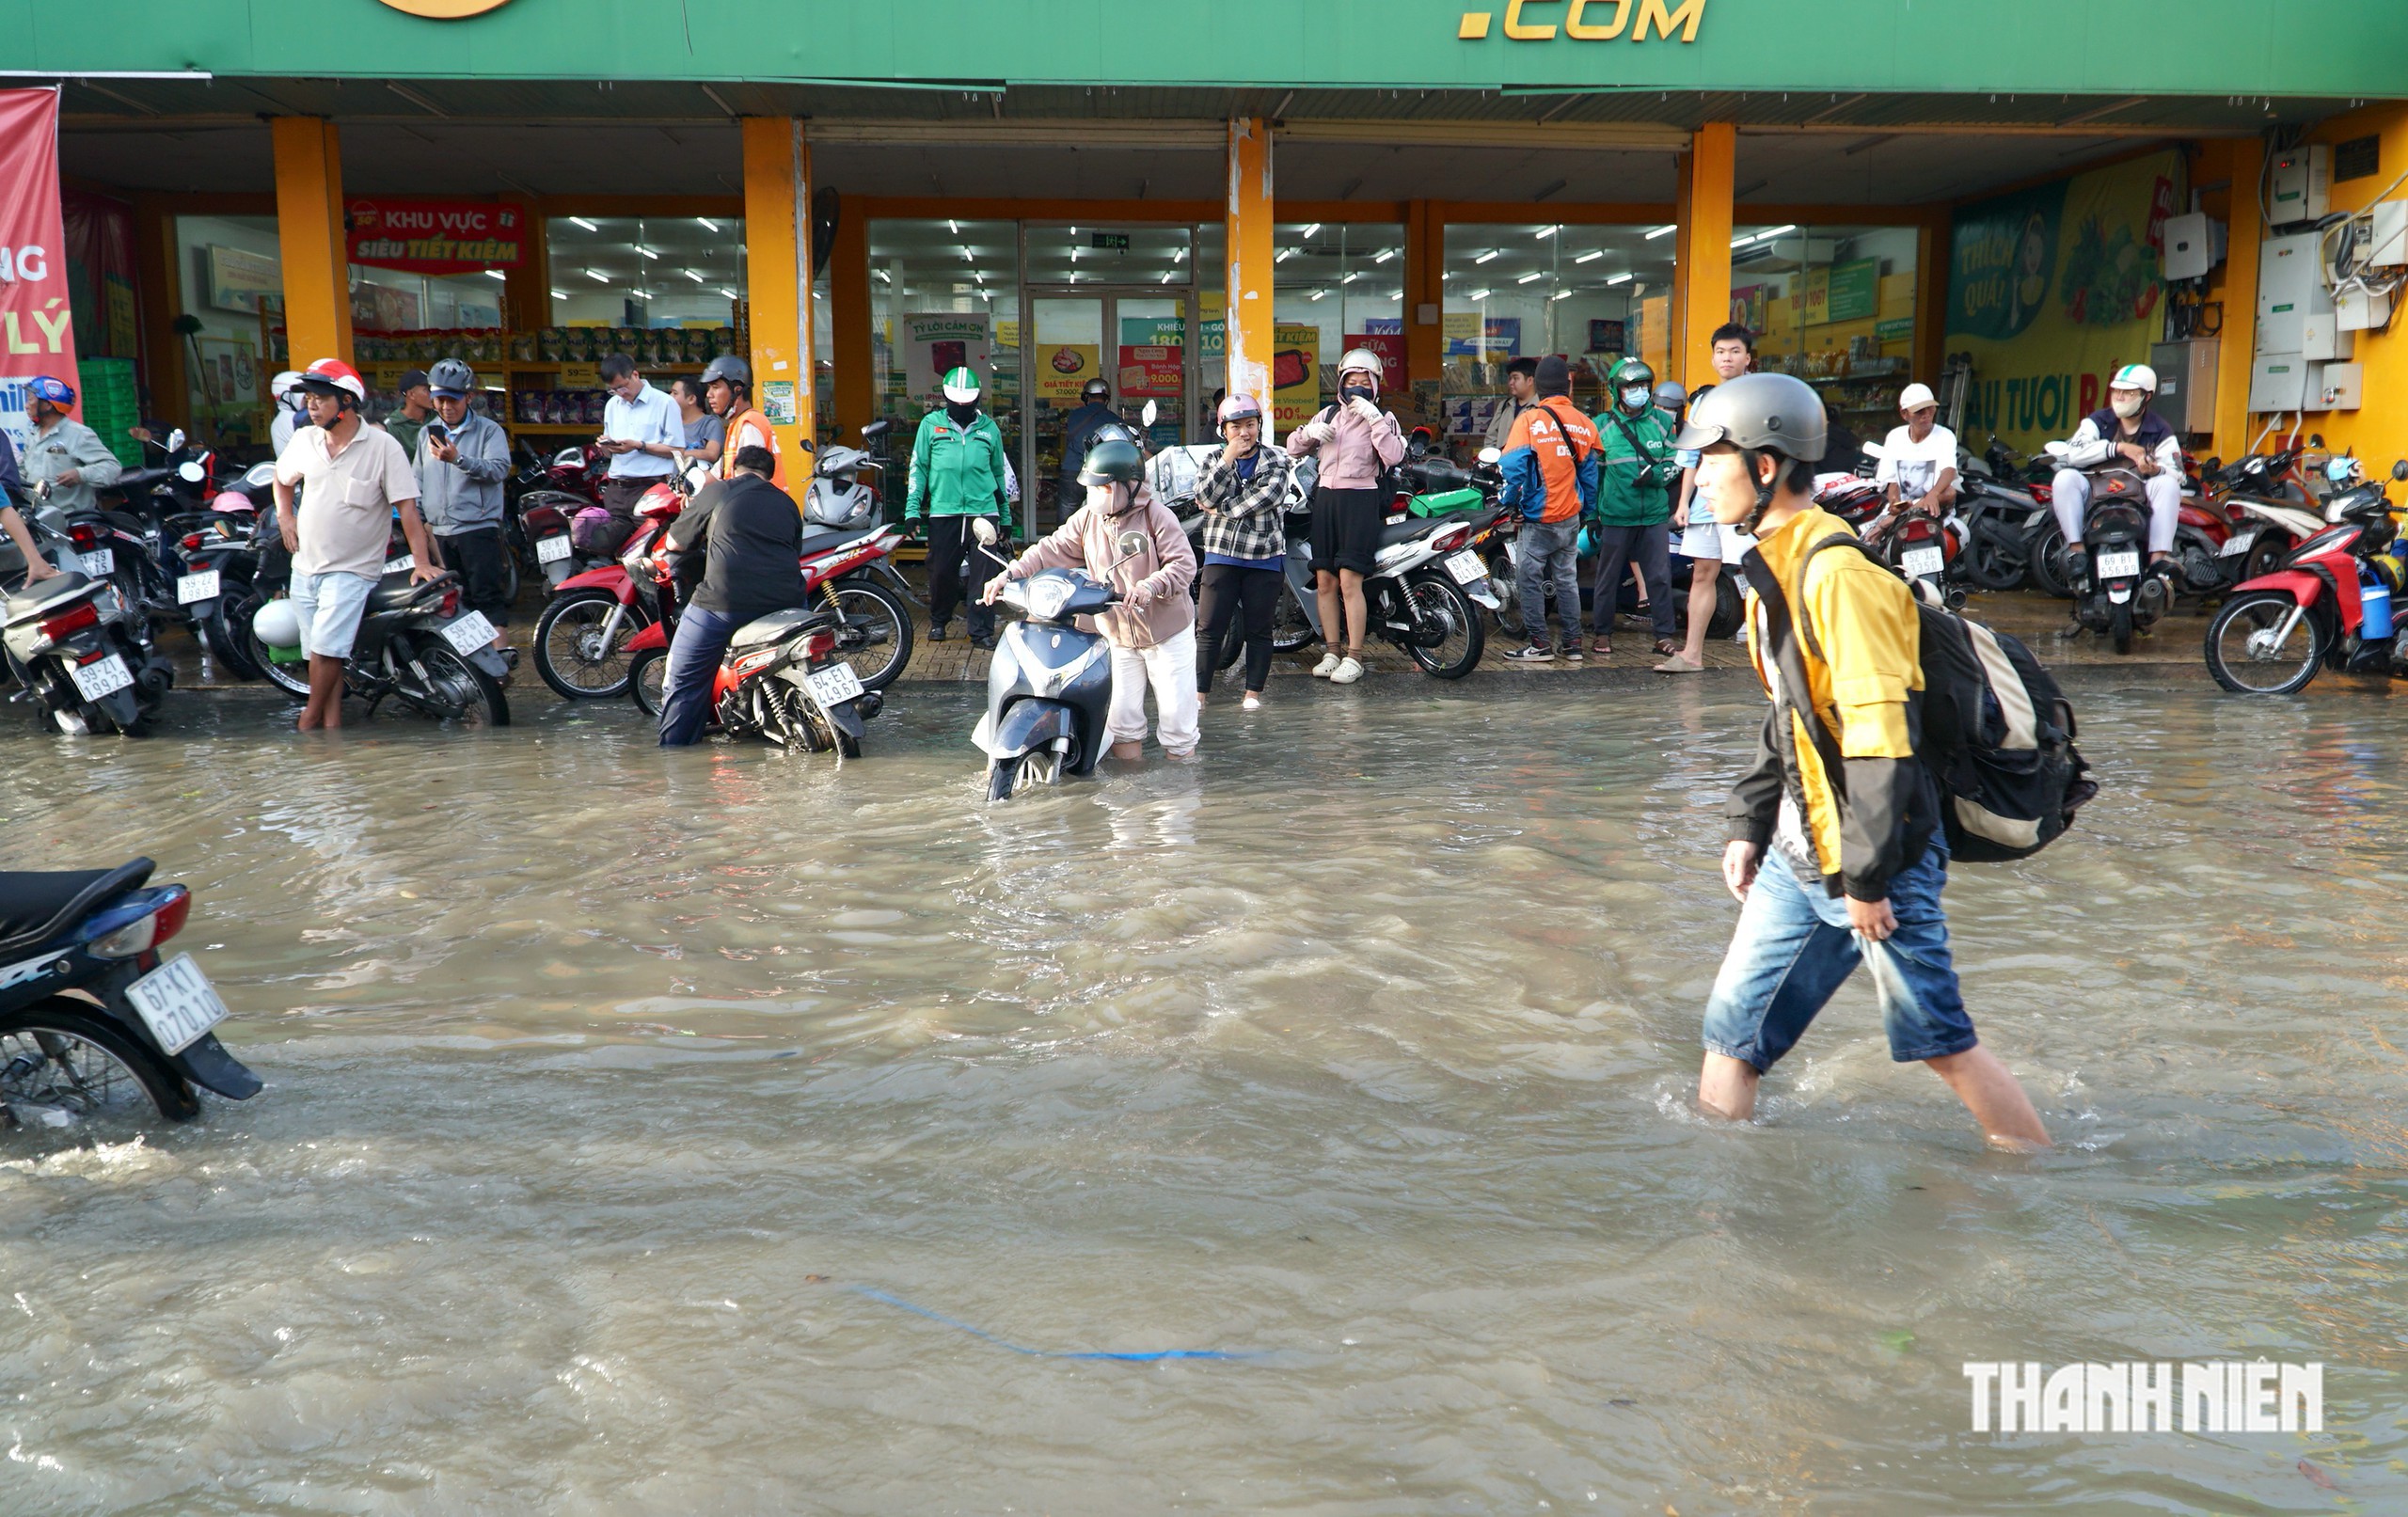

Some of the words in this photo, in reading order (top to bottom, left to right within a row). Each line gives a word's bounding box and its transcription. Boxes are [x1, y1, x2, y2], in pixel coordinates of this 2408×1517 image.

[1459, 0, 1706, 42] .COM
[385, 211, 434, 228] KHU
[438, 211, 487, 233] VỰC
[356, 235, 405, 259] SIÊU
[407, 231, 457, 261] TIẾT
[455, 235, 518, 266] KIỆM
[1962, 234, 2015, 276] THÍCH
[5, 298, 71, 354] LÝ
[1157, 321, 1185, 331] KHIẾU
[1212, 322, 1225, 331] GÓ
[1360, 339, 1387, 352] SỮA
[1044, 379, 1057, 388] GIÁ
[1058, 379, 1073, 387] TIẾT
[2005, 373, 2072, 434] TƯƠI
[184, 574, 213, 590] 59-Z2
[80, 658, 118, 684] 59-Z1
[84, 670, 131, 700] 199.23
[812, 668, 847, 690] 64-E1
[816, 679, 858, 705] 449.67
[140, 962, 199, 1012] 67-K1
[156, 988, 222, 1049] 070.10
